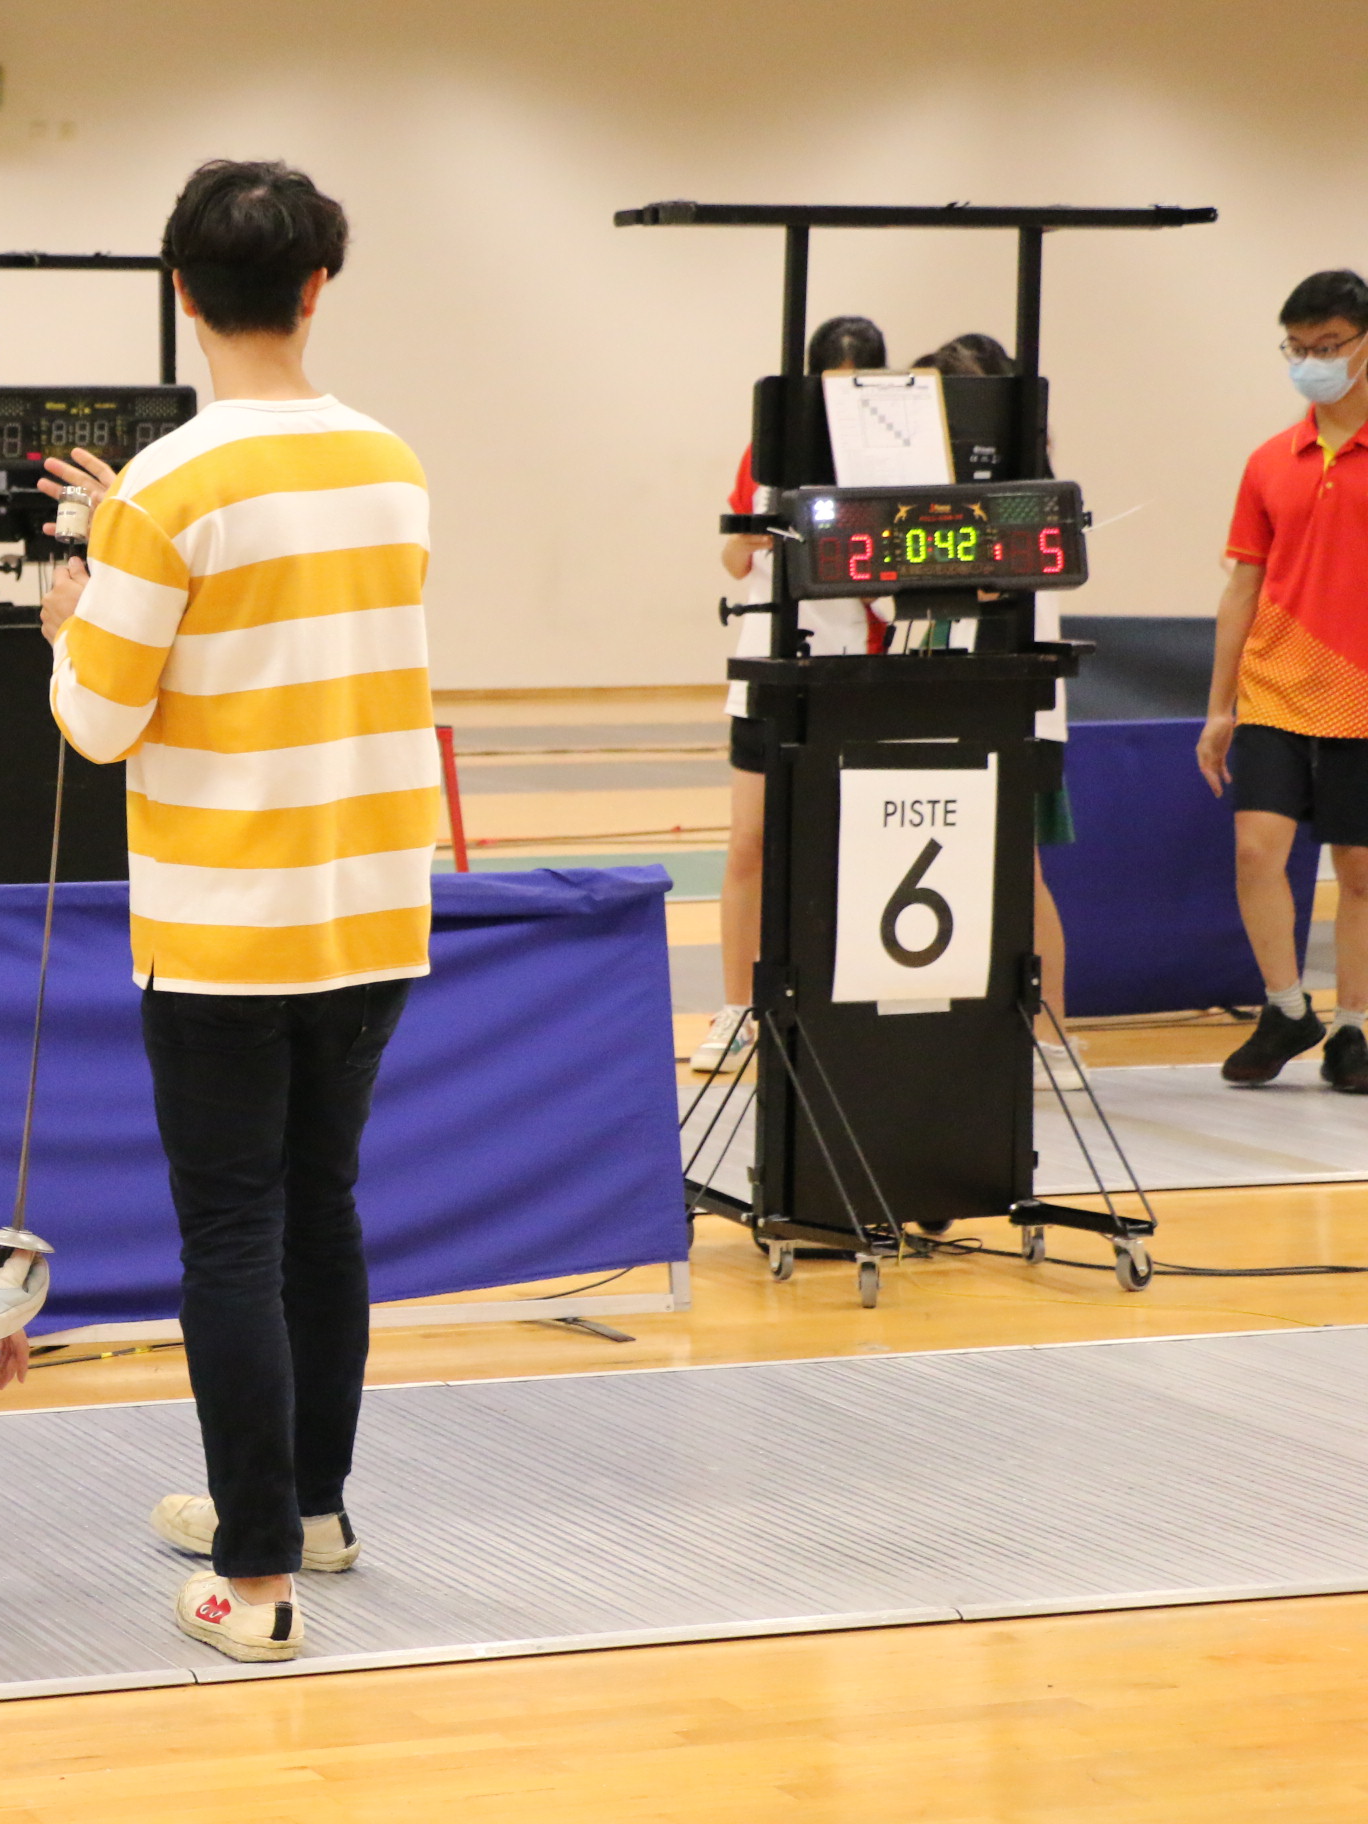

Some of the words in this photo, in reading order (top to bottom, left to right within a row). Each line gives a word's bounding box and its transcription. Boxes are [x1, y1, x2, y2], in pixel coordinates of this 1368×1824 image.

[849, 534, 873, 580] 2
[905, 526, 977, 563] 0:42
[1039, 527, 1064, 573] 5
[883, 799, 958, 828] PISTE
[879, 837, 954, 969] 6
